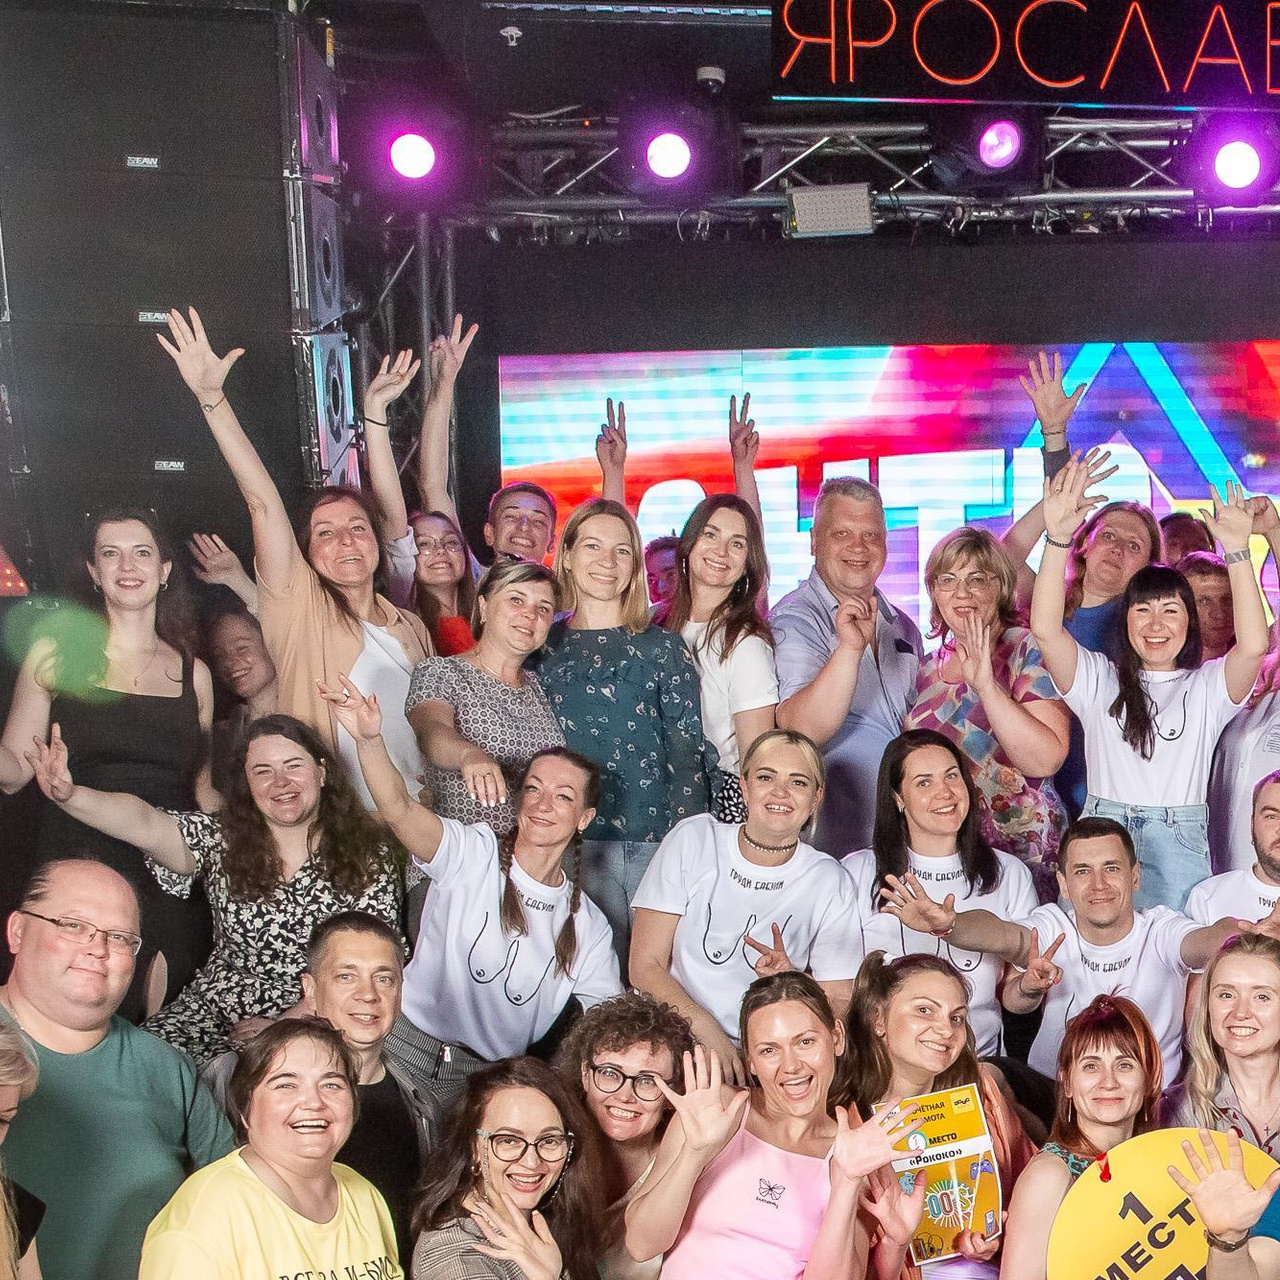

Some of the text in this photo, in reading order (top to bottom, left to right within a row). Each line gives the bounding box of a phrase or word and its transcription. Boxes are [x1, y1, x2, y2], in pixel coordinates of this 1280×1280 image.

[911, 1102, 946, 1115] ОЧЁТНАЯ
[928, 1132, 958, 1146] МЕСТО
[1118, 1190, 1154, 1226] 1
